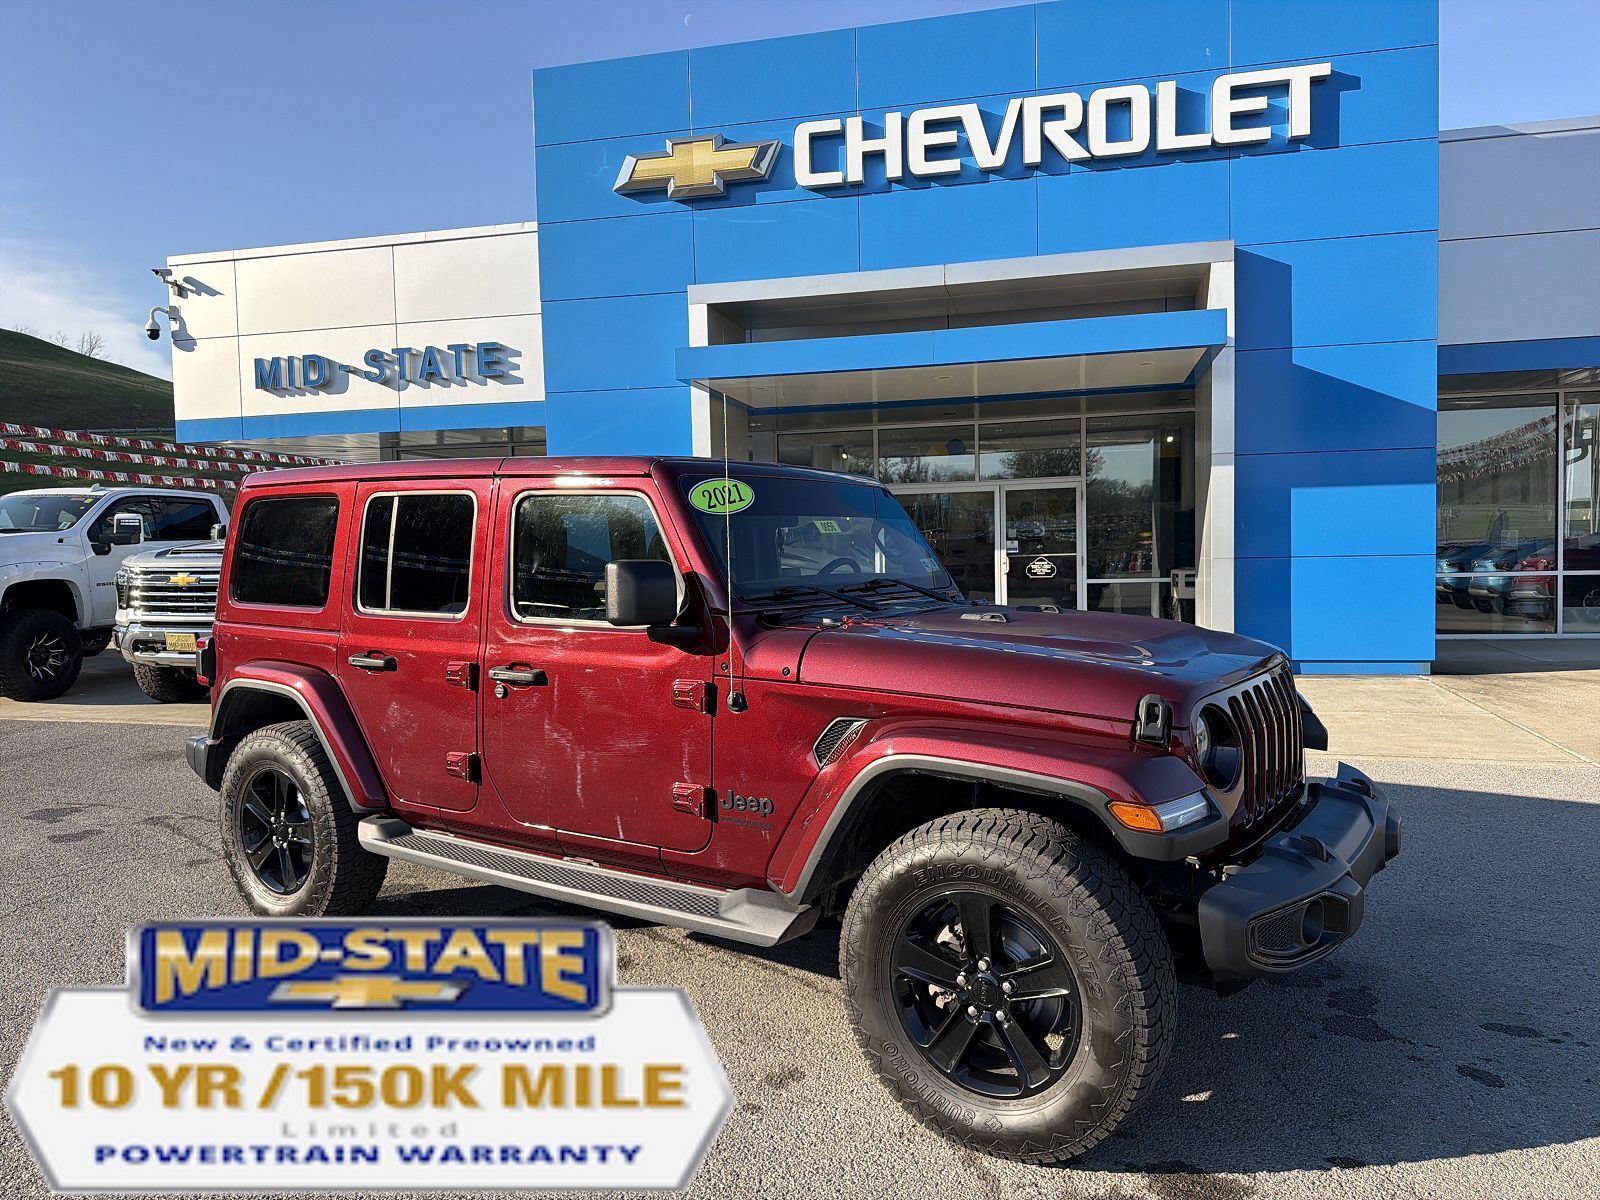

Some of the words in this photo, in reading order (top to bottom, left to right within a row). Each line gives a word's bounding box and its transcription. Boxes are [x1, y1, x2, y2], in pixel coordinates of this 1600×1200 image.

[793, 61, 1332, 190] CHEVROLET
[701, 483, 746, 510] 2021
[720, 789, 775, 817] Jeep
[912, 861, 1072, 937] ENCOUNTER
[1069, 943, 1103, 1000] AT2
[882, 1041, 976, 1127] SUMITOMO
